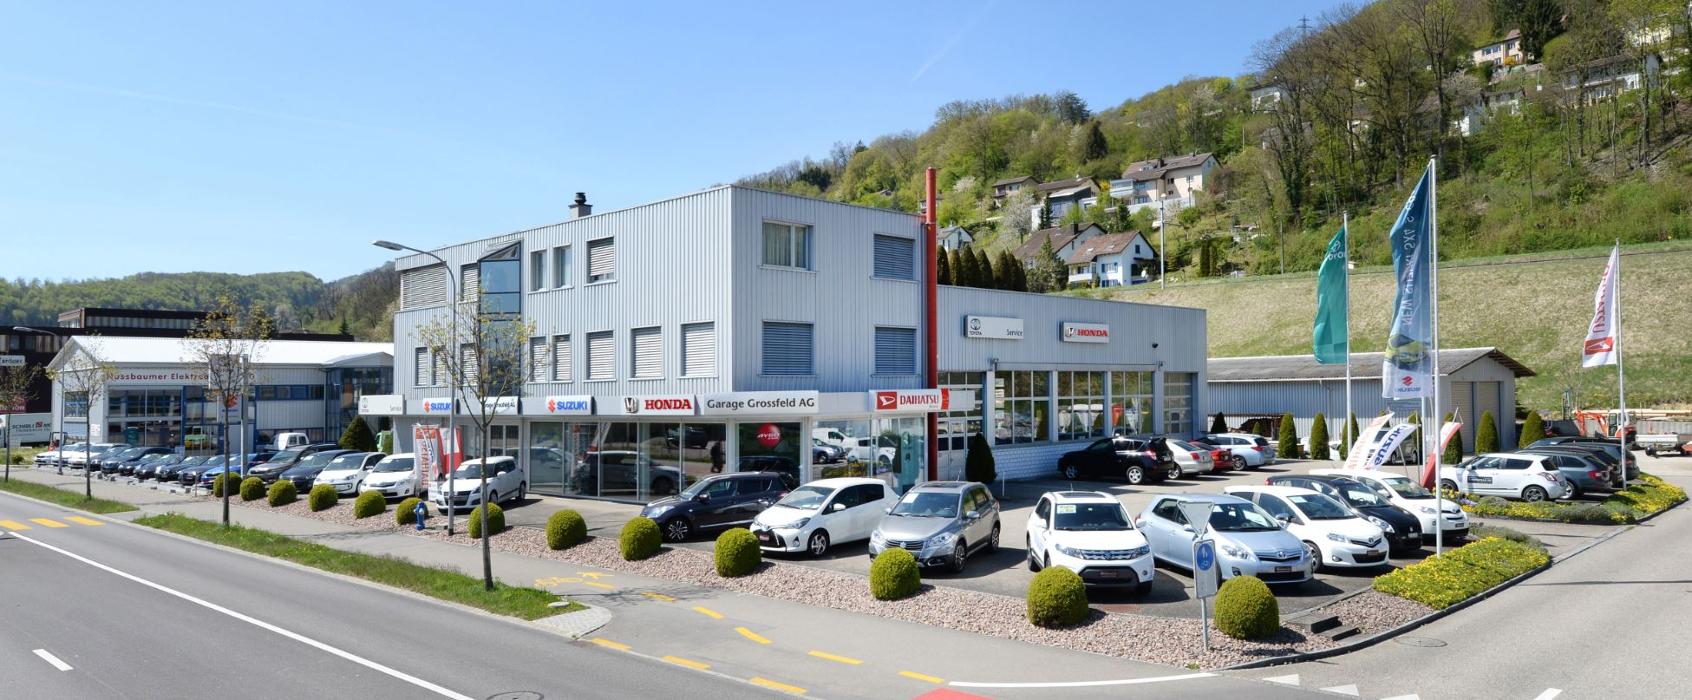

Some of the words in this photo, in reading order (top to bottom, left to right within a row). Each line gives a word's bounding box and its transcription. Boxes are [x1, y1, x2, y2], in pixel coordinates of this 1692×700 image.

[1006, 328, 1023, 336] Service
[1077, 329, 1108, 338] HONDA
[644, 399, 692, 410] HONDA
[707, 399, 745, 411] Garage
[747, 398, 796, 408] Grossfeld
[798, 397, 815, 407] AG
[899, 394, 939, 406] DAIHATSU
[430, 402, 452, 411] SUZUK
[556, 401, 588, 411] SUZUKI
